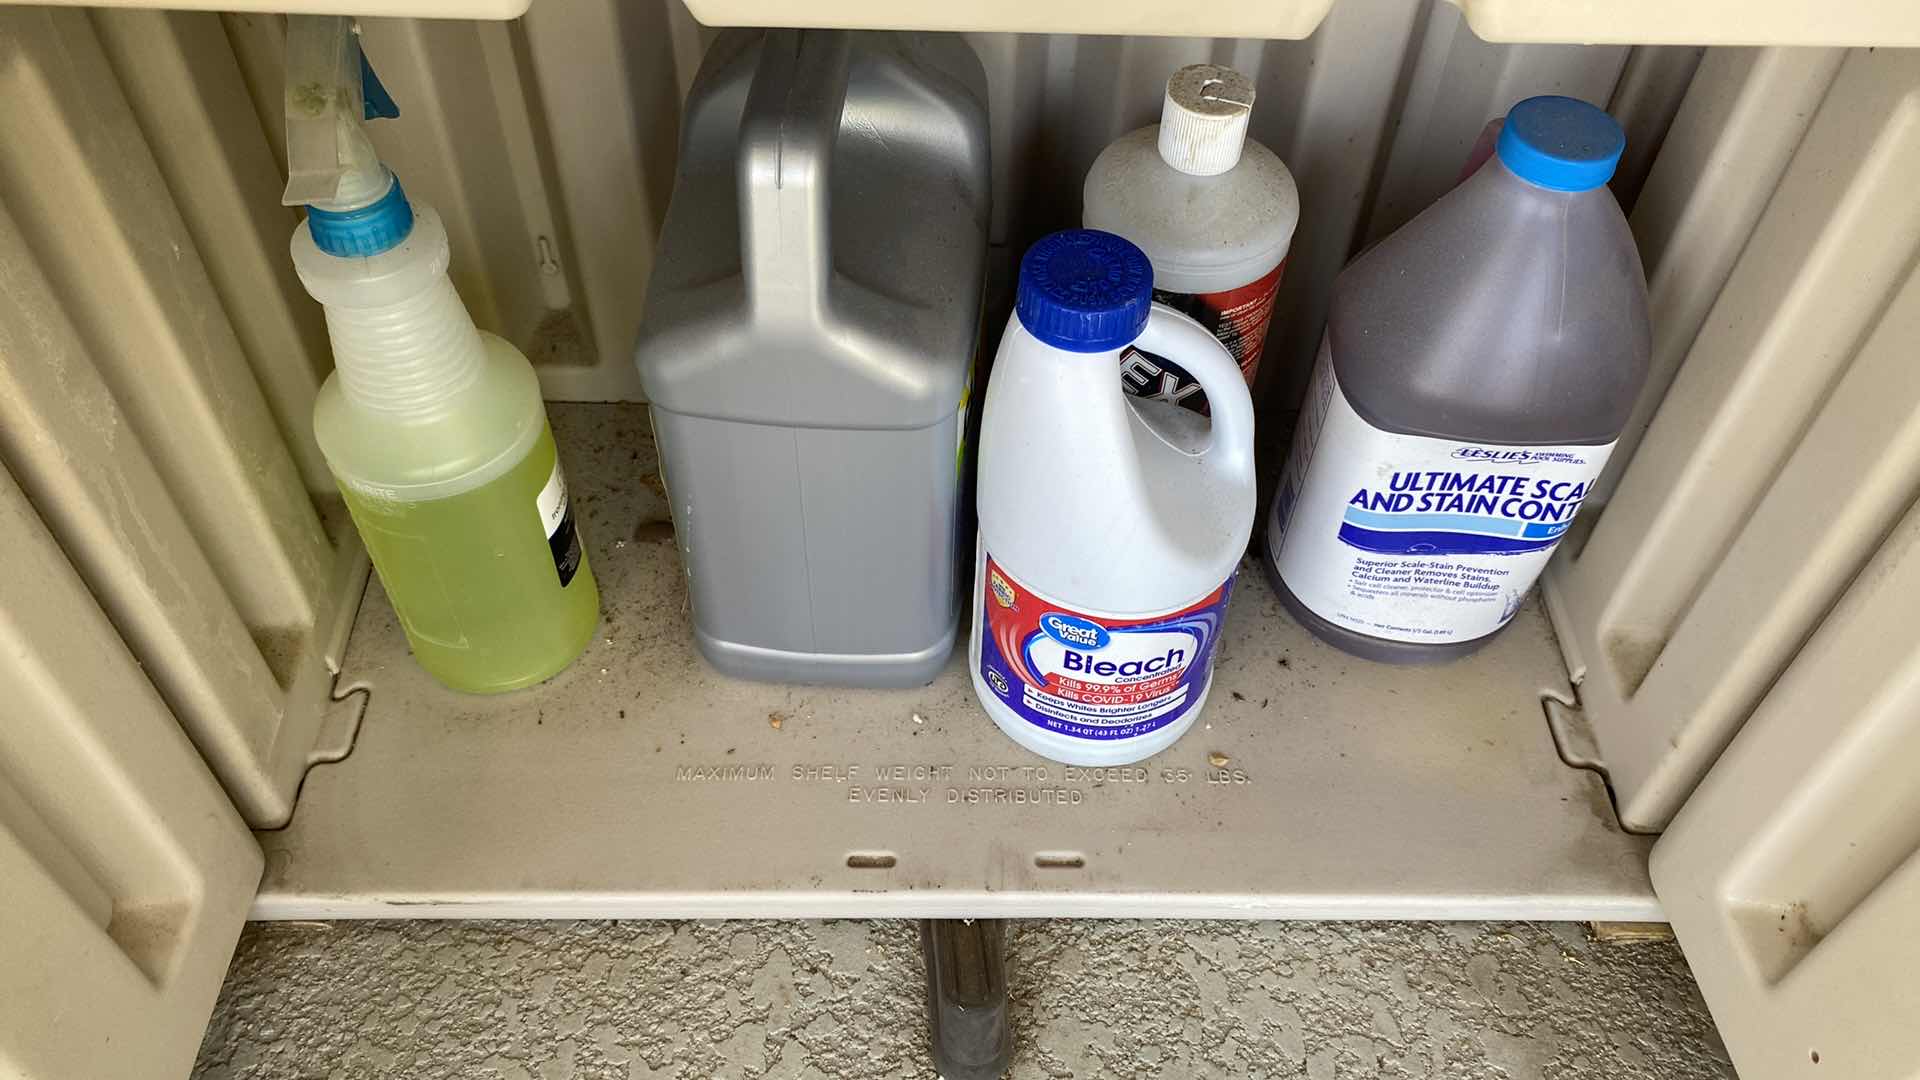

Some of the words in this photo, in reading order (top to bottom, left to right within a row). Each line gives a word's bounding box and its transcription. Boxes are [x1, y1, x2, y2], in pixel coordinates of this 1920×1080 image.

[1390, 472, 1530, 496] ULTIMATE
[1349, 488, 1414, 513] AND
[1416, 492, 1500, 516] STAIN
[1353, 565, 1373, 573] and
[1374, 567, 1412, 576] Cleaner
[1413, 569, 1458, 579] Removes
[1356, 557, 1398, 568] Superior
[1400, 560, 1454, 570] Scale-Stain
[1456, 564, 1510, 577] Prevention
[1351, 571, 1391, 582] Calcium
[1413, 577, 1461, 587] Waterline
[1463, 581, 1501, 591] Buildup
[1048, 616, 1098, 640] Great
[1060, 631, 1097, 647] Value
[1063, 648, 1185, 677] Bleach
[1114, 662, 1182, 684] Concentrated
[1059, 677, 1082, 690] Kills
[1085, 683, 1122, 694] 99.9%
[1123, 685, 1137, 693] of
[1036, 692, 1065, 706] Keeps
[1066, 702, 1097, 713] Whites
[1099, 705, 1136, 714] Brighter
[1057, 688, 1080, 701] Kills
[1082, 693, 1143, 704] COVID-19
[1036, 703, 1078, 721] Disinfects
[1101, 713, 1153, 725] Deodorizes
[1047, 719, 1063, 729] NET
[1064, 724, 1081, 734] 1.34
[675, 764, 776, 781] MAXIMUM
[791, 764, 861, 782] SHELF
[874, 765, 954, 782] WEIGHT
[968, 766, 1010, 782] NOT
[1022, 767, 1048, 782] TO
[1064, 767, 1149, 784] EXCEED
[1162, 768, 1188, 784] 35
[849, 787, 930, 804] EVENLY
[946, 788, 1083, 805] DISTRIBUTED
